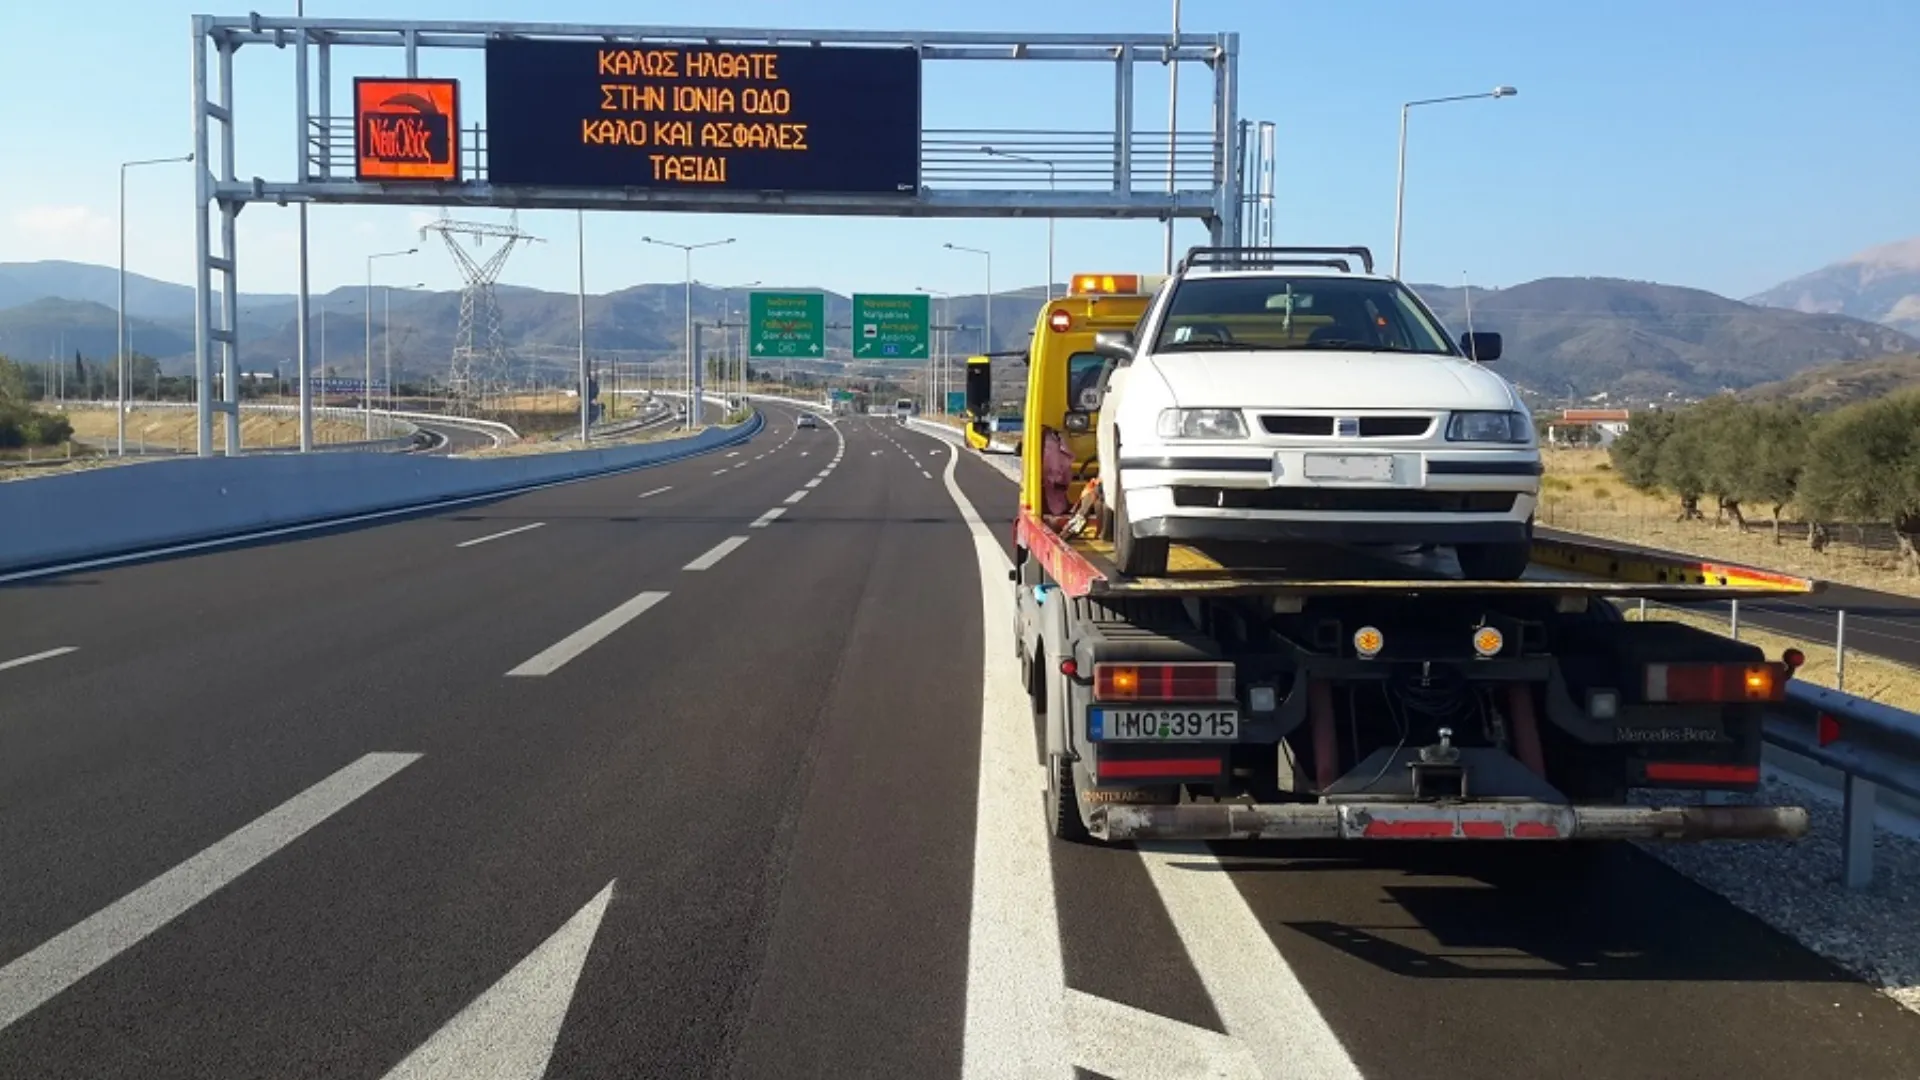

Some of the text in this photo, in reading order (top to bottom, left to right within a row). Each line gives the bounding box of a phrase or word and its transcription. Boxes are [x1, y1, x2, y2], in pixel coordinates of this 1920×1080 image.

[599, 51, 776, 79] ΚΑΛΩΣ ΗΛΘΑΤΕ
[602, 85, 789, 114] ΣΤΗΝ ΙΟΝΙΑ ΟΔΟ
[584, 120, 806, 149] ΚΑΛΟ ΚΑΙ ΑΣΦΑΛΕΣ
[651, 155, 725, 181] ΤΑΞΙΔΙ
